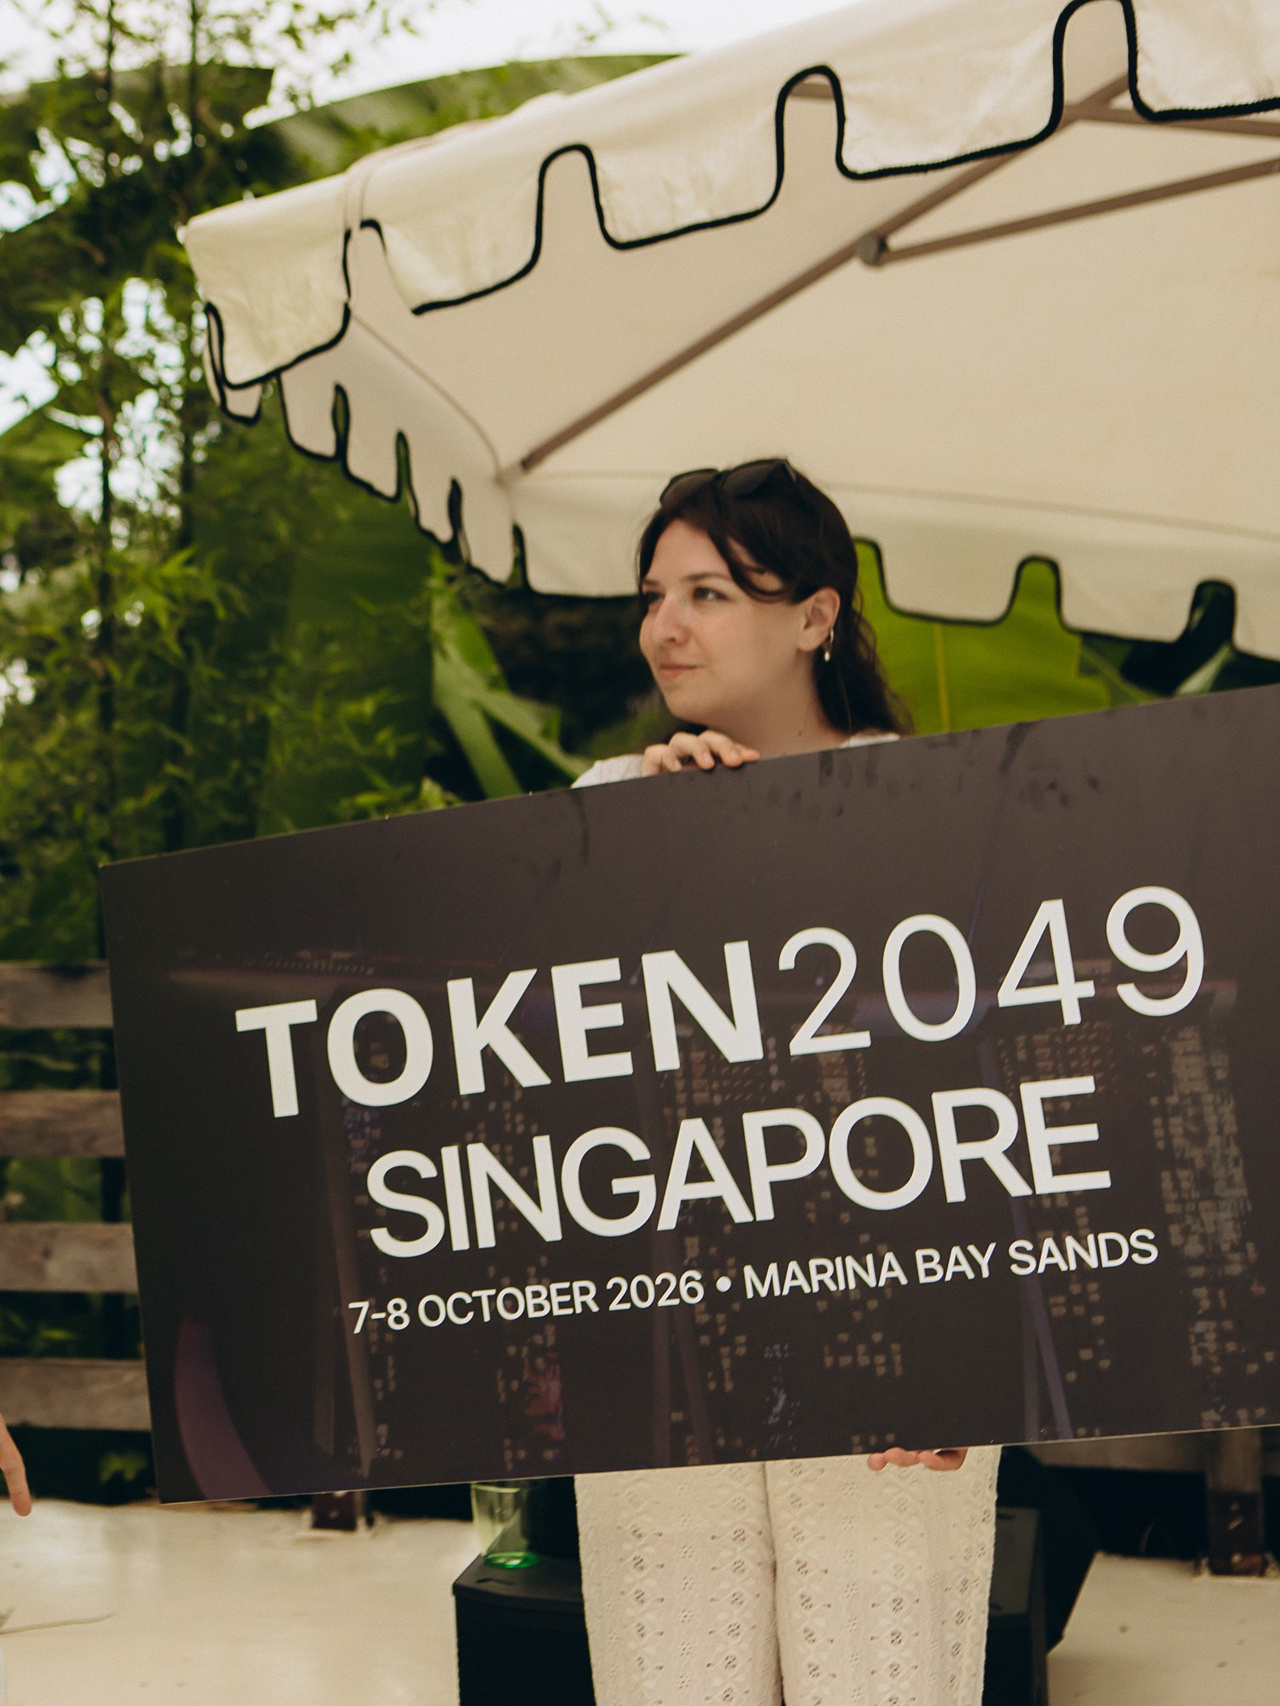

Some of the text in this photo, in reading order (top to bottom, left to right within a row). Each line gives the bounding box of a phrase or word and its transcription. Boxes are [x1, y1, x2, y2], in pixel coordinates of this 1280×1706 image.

[235, 886, 1204, 1118] TOKEN2049
[367, 1075, 1112, 1258] SINGAPORE
[418, 1280, 600, 1328] OCTOBER
[606, 1269, 705, 1311] 2026
[743, 1251, 908, 1299] MARINA
[915, 1242, 997, 1284] BAY
[1008, 1228, 1159, 1276] SANDS
